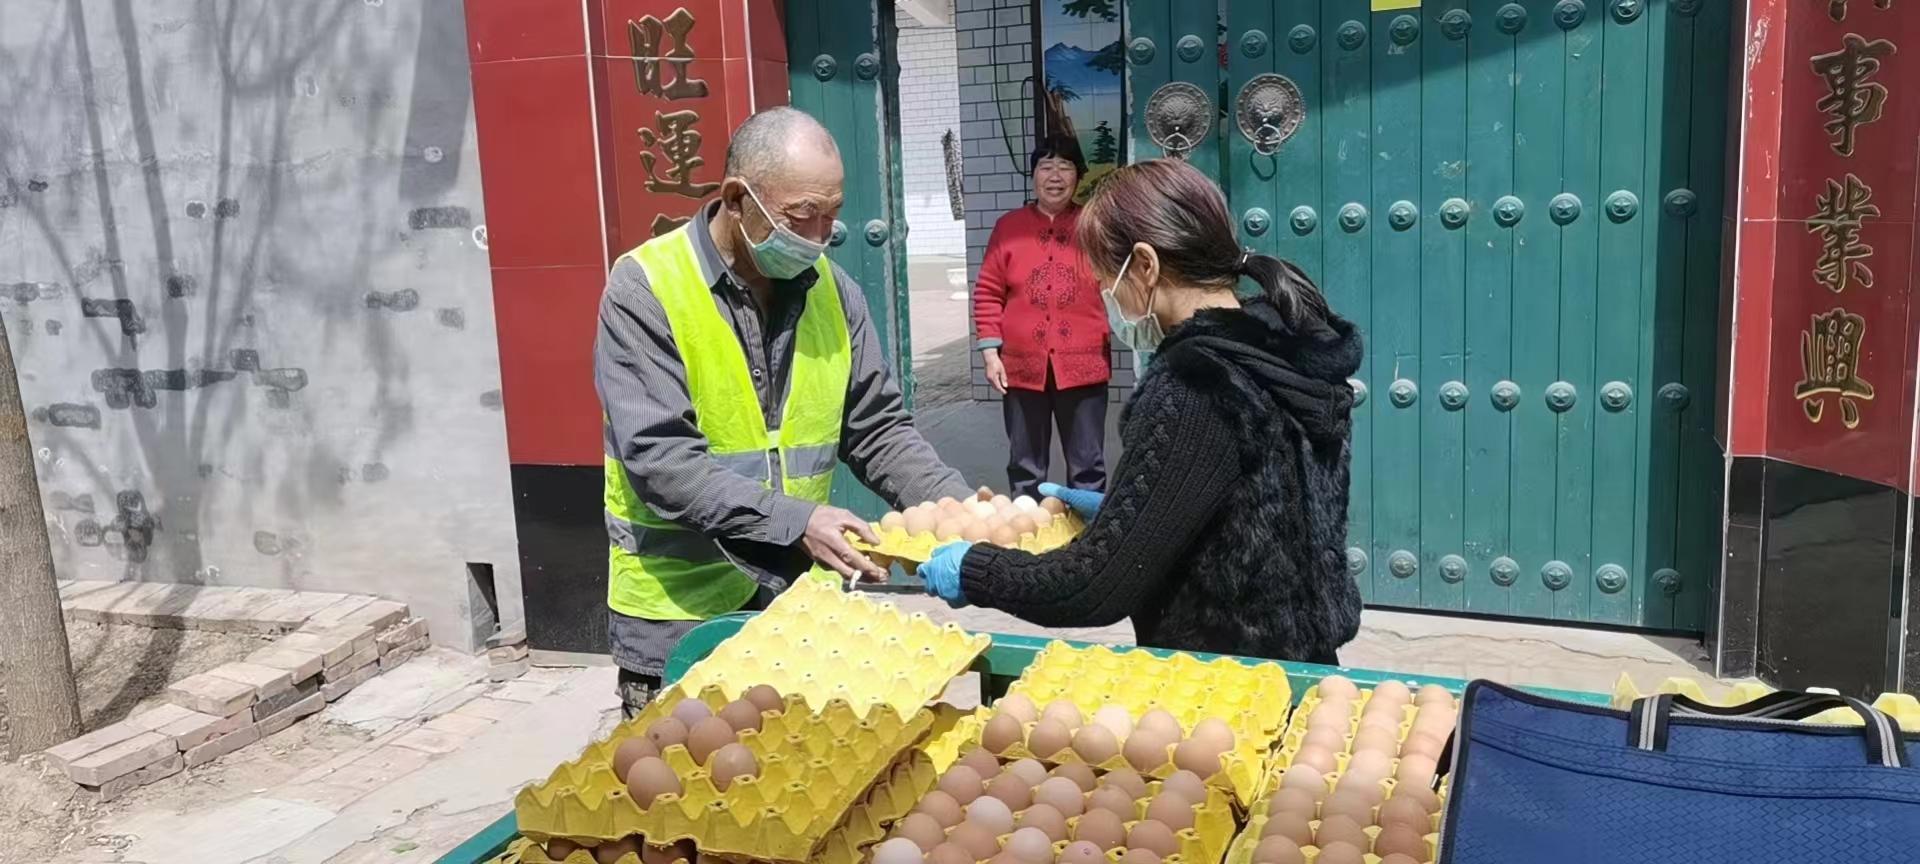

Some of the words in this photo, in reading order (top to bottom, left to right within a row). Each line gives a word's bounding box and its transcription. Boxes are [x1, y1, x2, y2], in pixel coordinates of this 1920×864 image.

[628, 7, 721, 238] 旺運
[1795, 0, 1897, 429] 事業興
